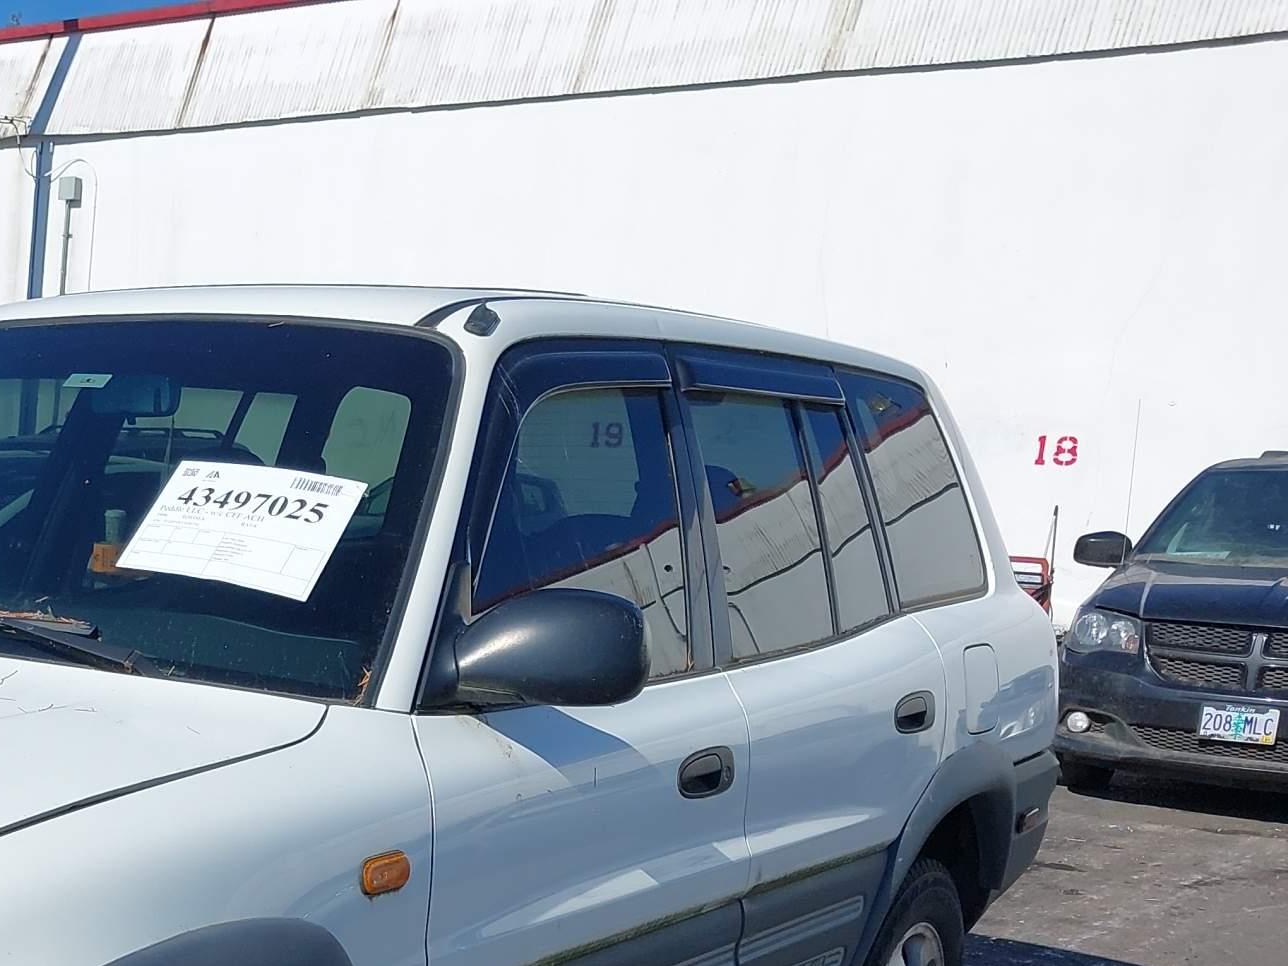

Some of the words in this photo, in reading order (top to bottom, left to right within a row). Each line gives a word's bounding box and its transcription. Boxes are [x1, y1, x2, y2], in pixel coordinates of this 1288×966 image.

[591, 422, 623, 448] 19
[1035, 435, 1078, 466] 18
[177, 486, 329, 523] 43497025
[1202, 712, 1233, 732] 208
[1243, 715, 1274, 736] MLC
